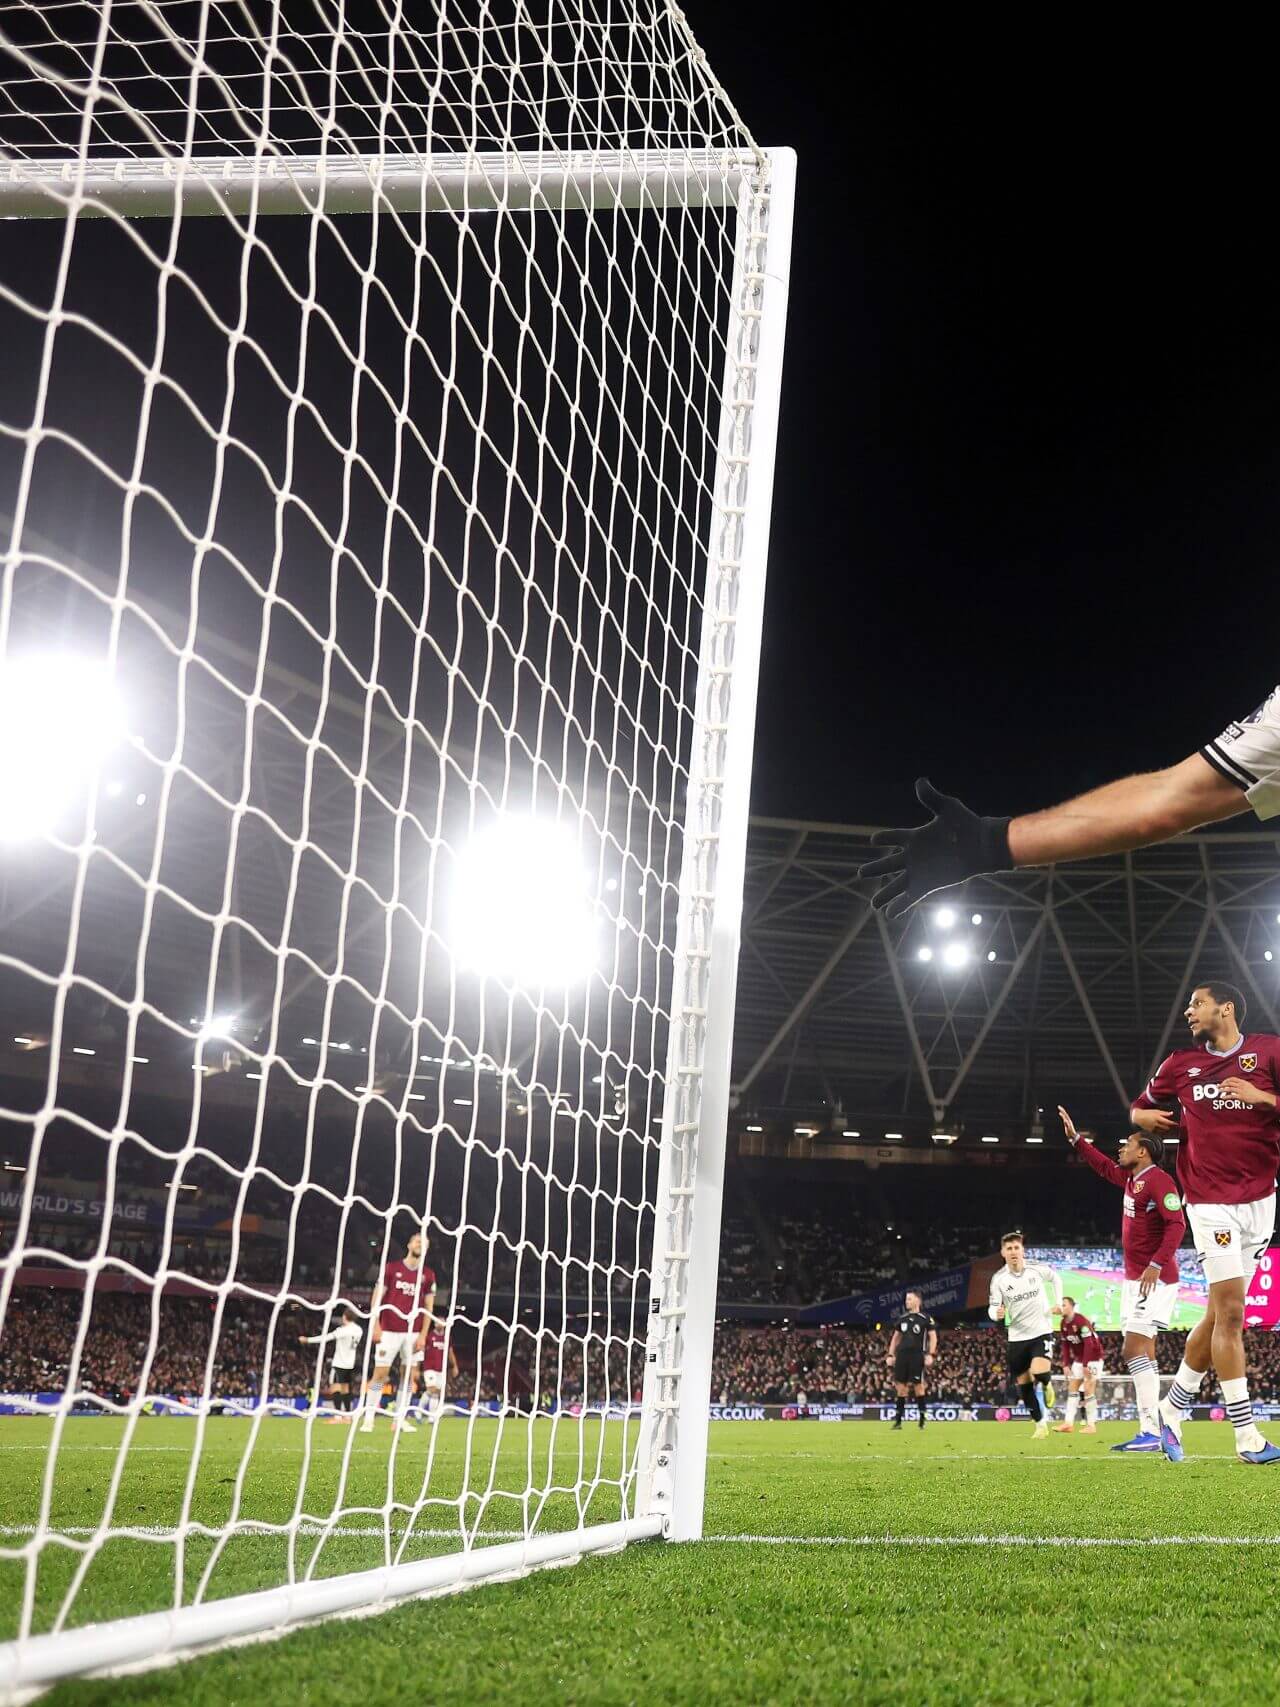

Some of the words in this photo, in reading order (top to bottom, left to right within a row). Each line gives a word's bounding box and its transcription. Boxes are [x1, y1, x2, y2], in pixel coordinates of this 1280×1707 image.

[88, 1199, 149, 1221] SAGE
[1260, 1256, 1272, 1272] 0
[1260, 1274, 1272, 1290] 0
[1135, 1296, 1148, 1310] 2
[708, 1408, 766, 1421] S.CO.UK
